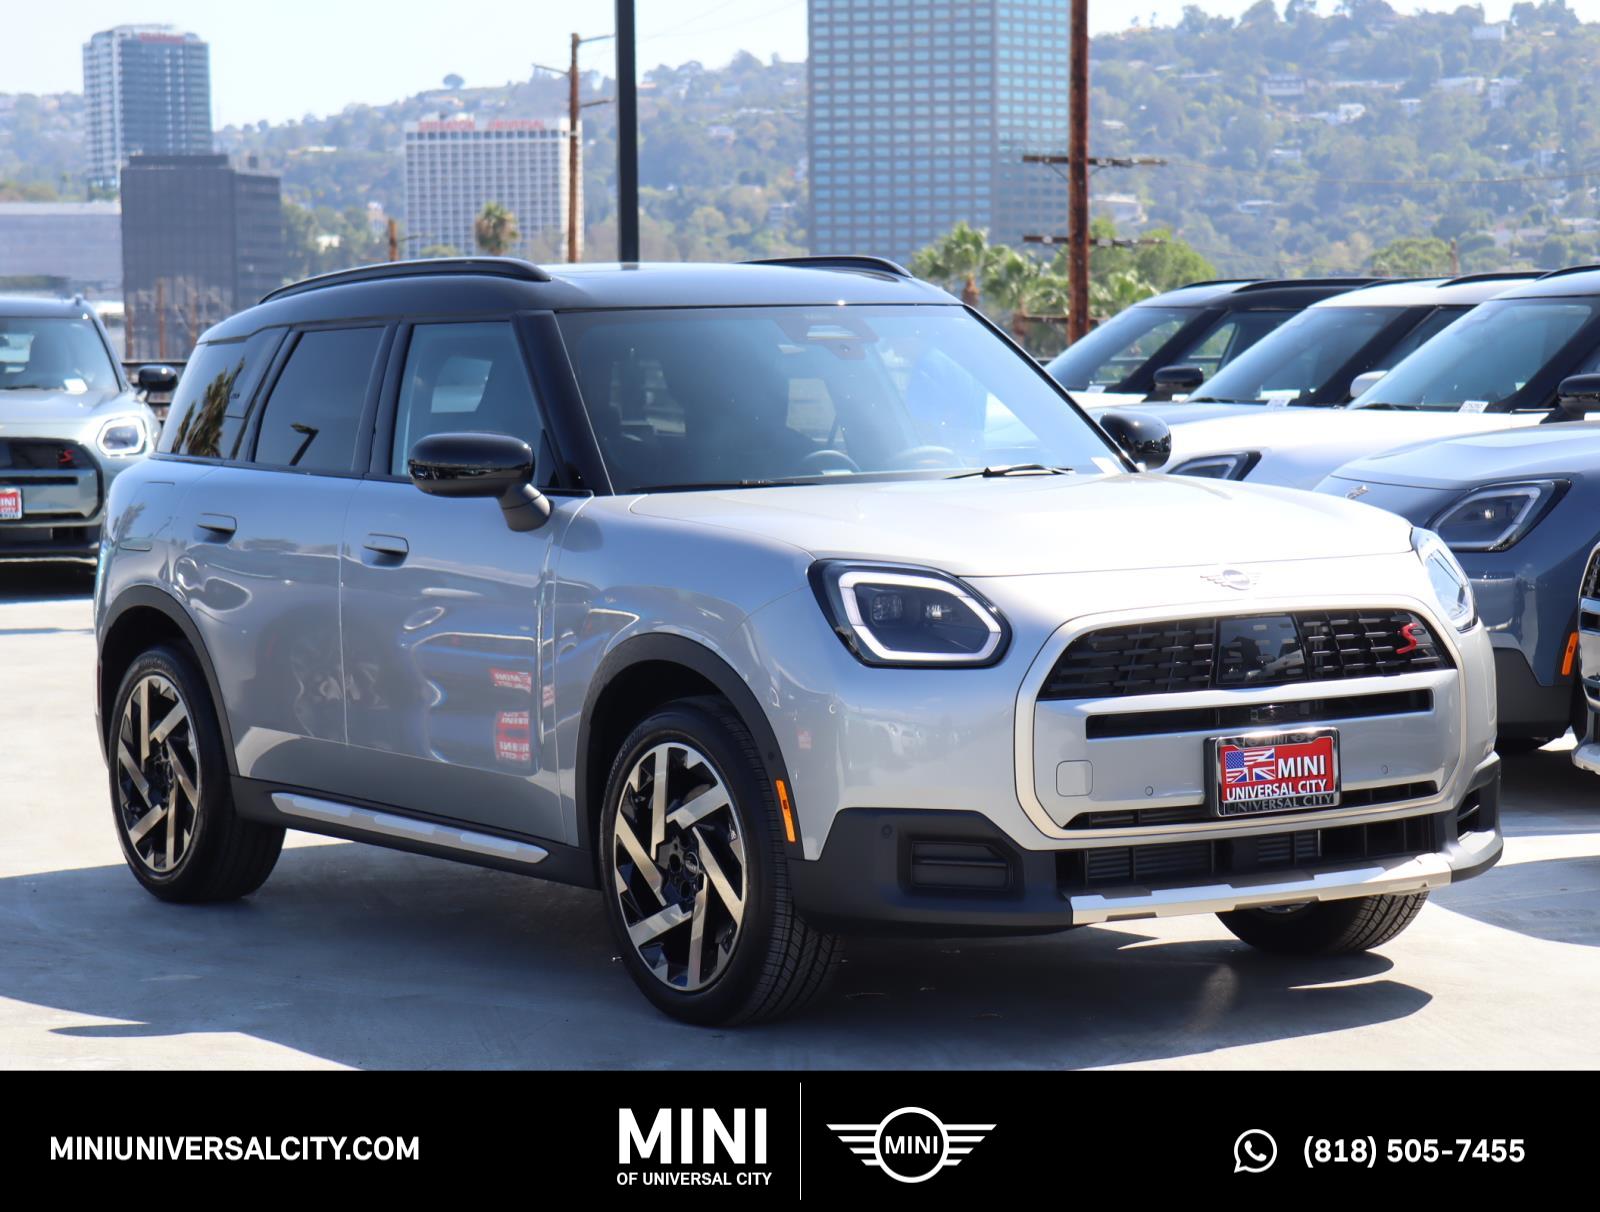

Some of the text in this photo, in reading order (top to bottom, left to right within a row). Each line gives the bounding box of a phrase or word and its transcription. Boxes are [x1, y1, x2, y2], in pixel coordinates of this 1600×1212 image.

[0, 496, 16, 506] INI
[1396, 622, 1419, 654] S
[1277, 755, 1325, 779] MINI
[1226, 779, 1328, 801] UNIVERSAL CITY
[1227, 794, 1333, 814] UNIVERSAL CITY
